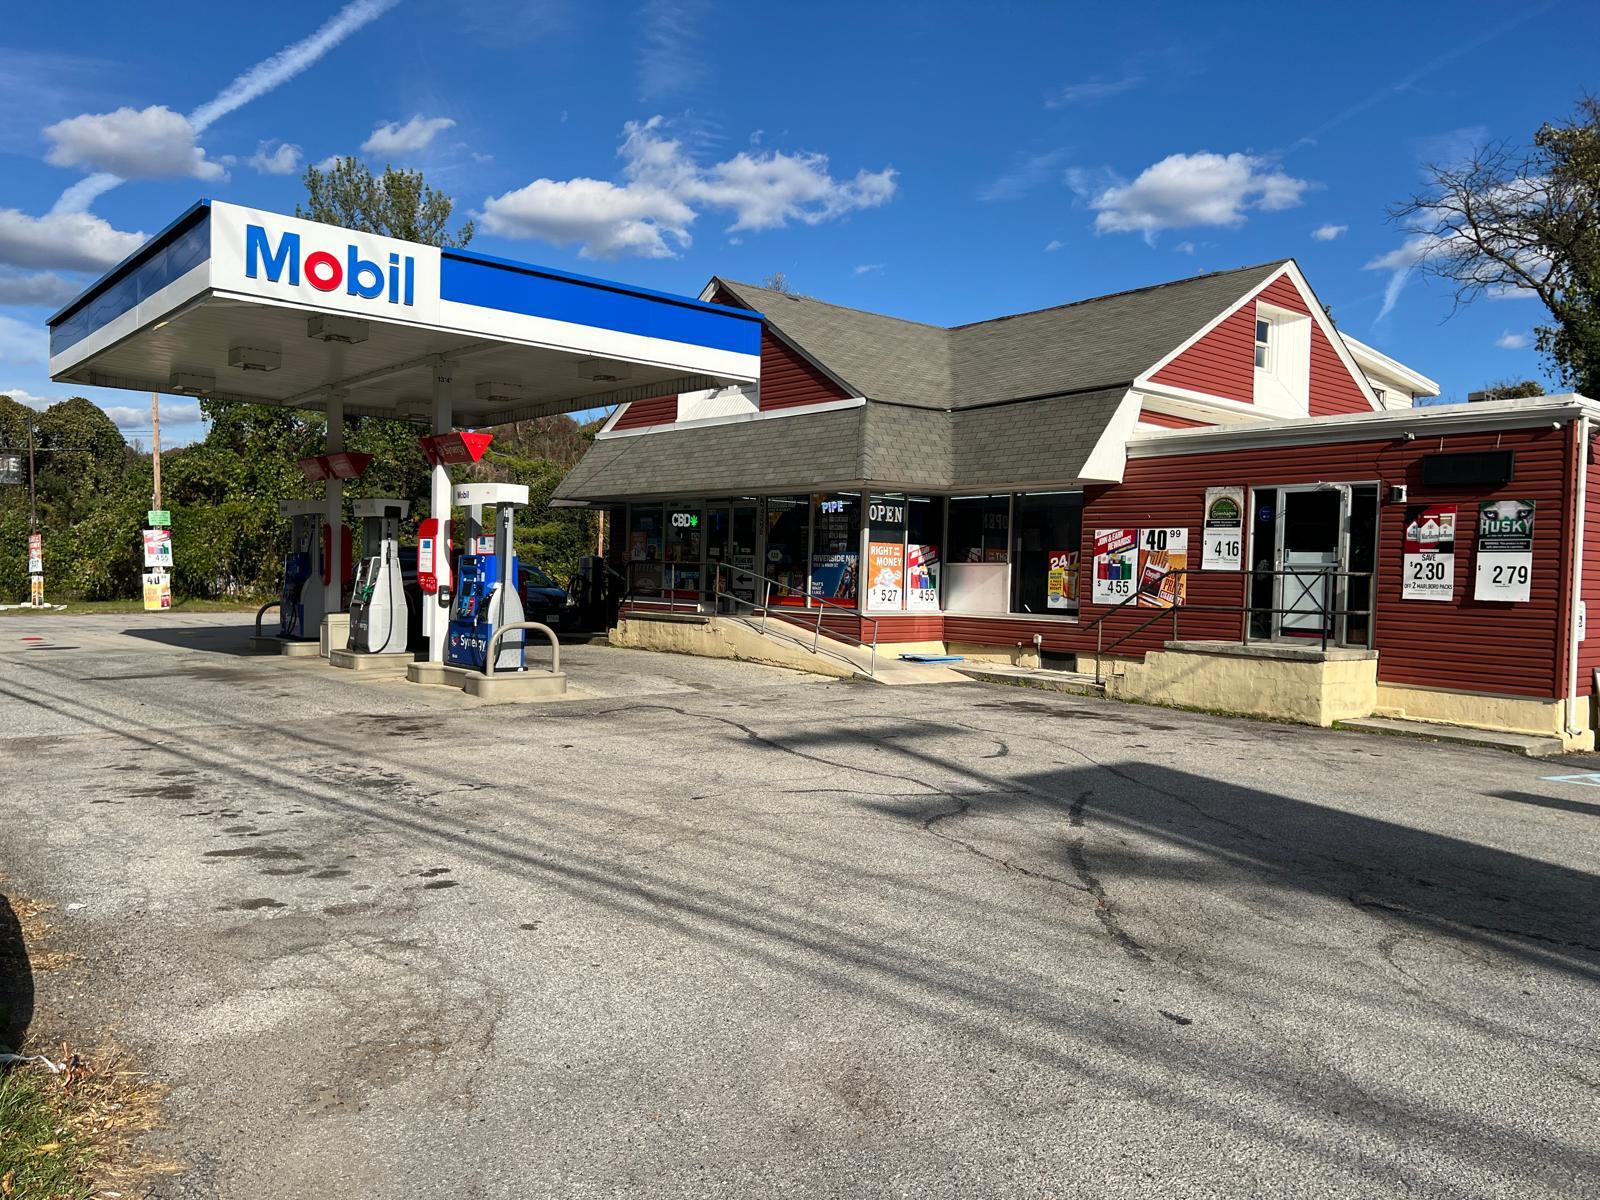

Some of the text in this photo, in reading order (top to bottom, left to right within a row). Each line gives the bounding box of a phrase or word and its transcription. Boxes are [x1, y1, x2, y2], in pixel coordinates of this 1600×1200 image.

[246, 223, 414, 307] Mobil
[821, 500, 844, 514] PIPE
[869, 504, 903, 523] OPEN
[672, 513, 691, 527] CBD
[1480, 518, 1533, 535] HUSKY
[1146, 529, 1167, 551] 40
[871, 545, 893, 556] RIGHT
[1422, 553, 1436, 561] SAVE
[812, 554, 845, 562] RIVERSIDE
[876, 556, 903, 567] MONEY
[461, 634, 487, 652] Synergy
